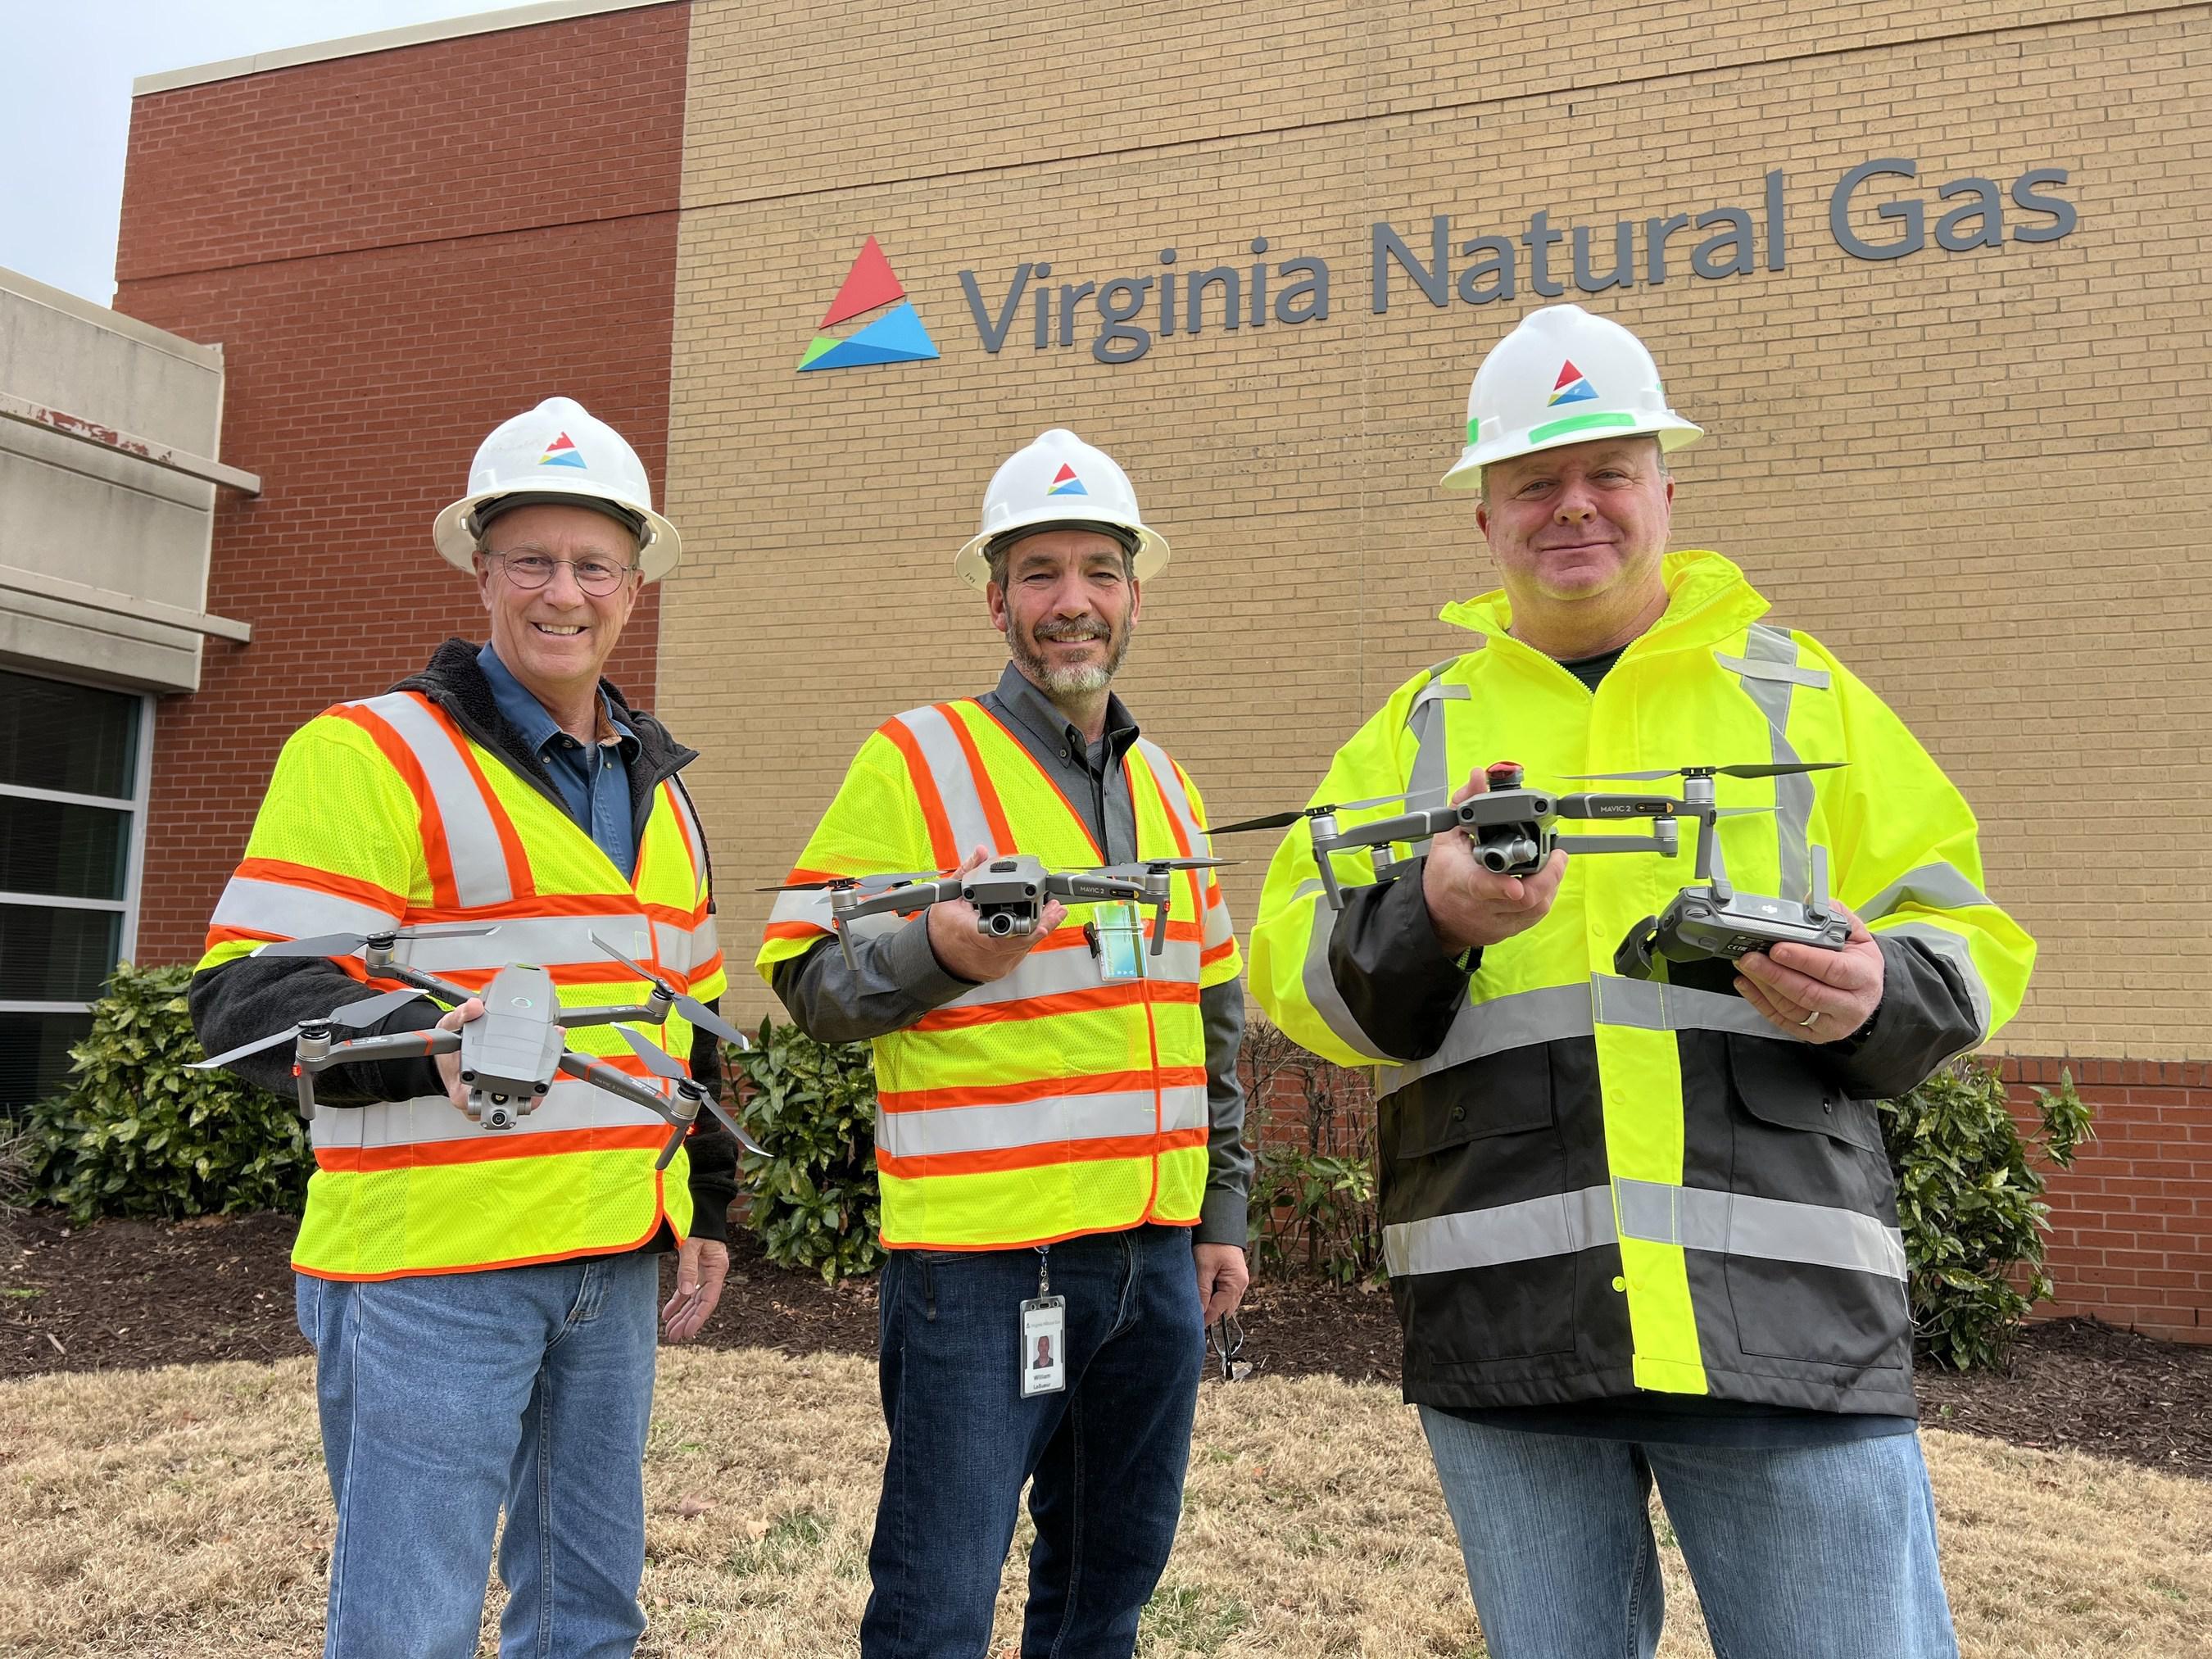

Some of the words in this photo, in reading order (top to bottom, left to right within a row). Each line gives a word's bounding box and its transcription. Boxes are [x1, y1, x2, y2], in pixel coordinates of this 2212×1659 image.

[959, 236, 1329, 364] Virginia
[1372, 167, 1786, 315] Natural
[1829, 156, 2078, 261] Gas
